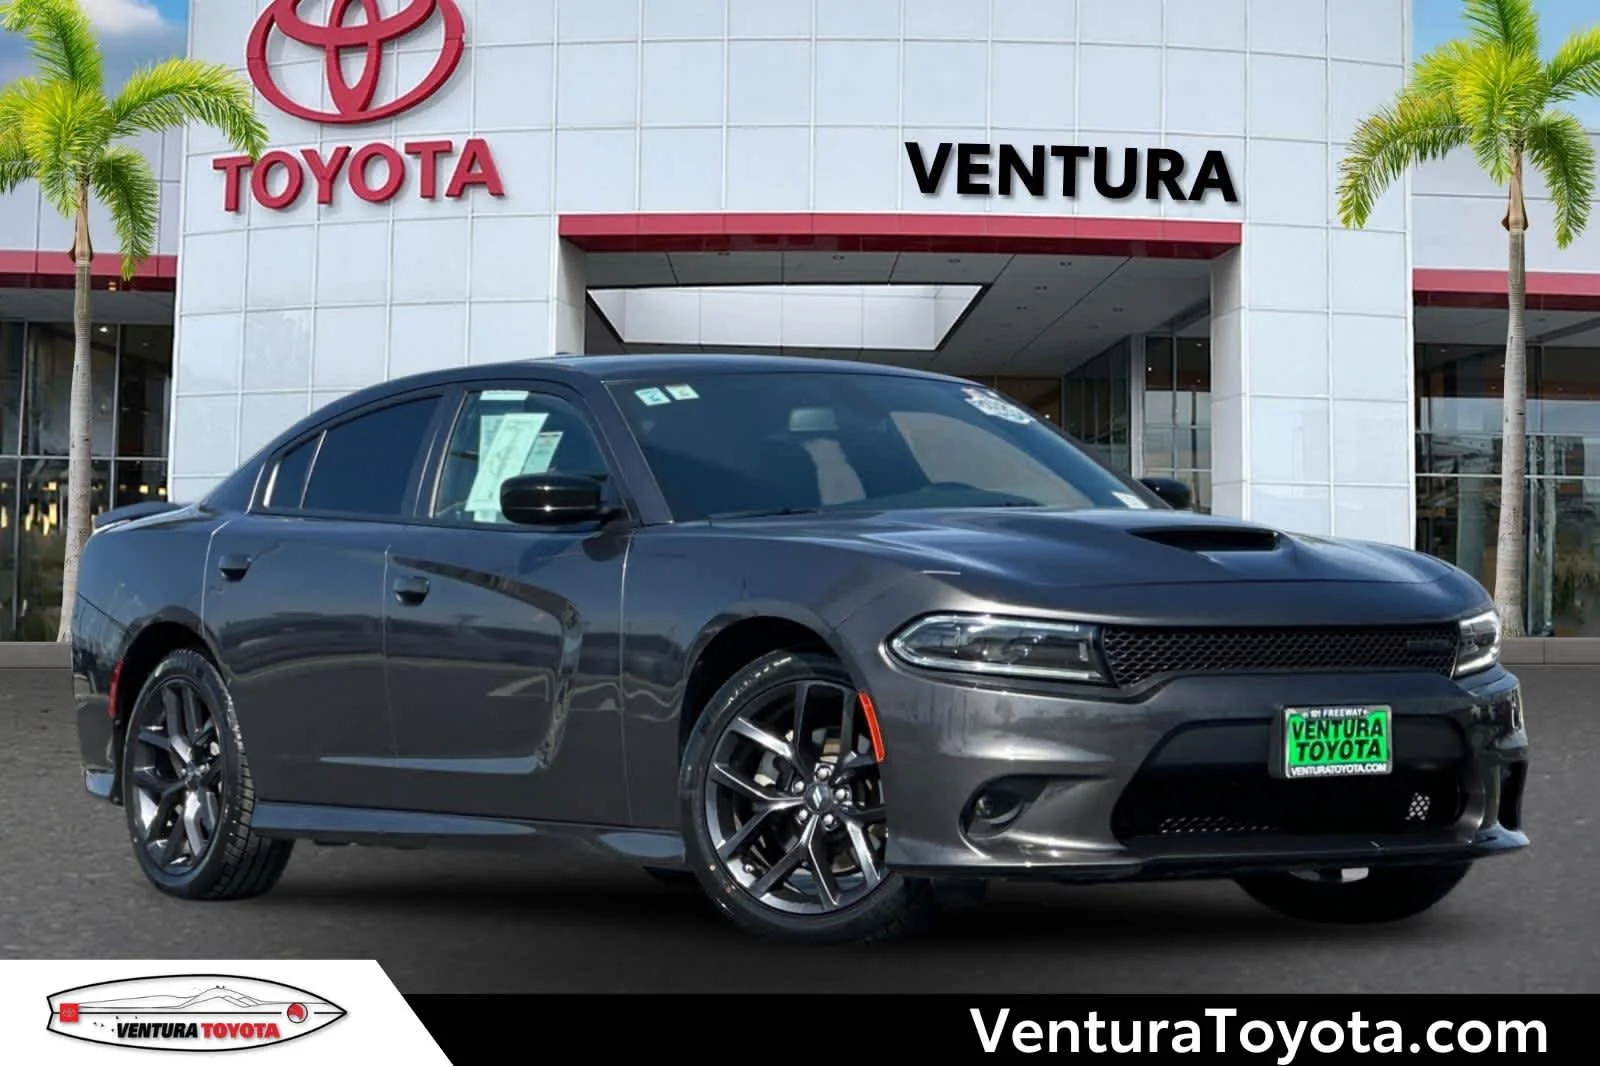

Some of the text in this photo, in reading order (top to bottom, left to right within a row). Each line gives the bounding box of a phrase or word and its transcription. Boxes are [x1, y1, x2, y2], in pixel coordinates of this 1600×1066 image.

[212, 137, 505, 213] TOYOTA
[904, 141, 1238, 203] VENTURA
[1292, 718, 1383, 740] VENTURA
[1296, 738, 1382, 761] TOYOTA
[1291, 763, 1386, 776] VENTURATOYOTA.COM
